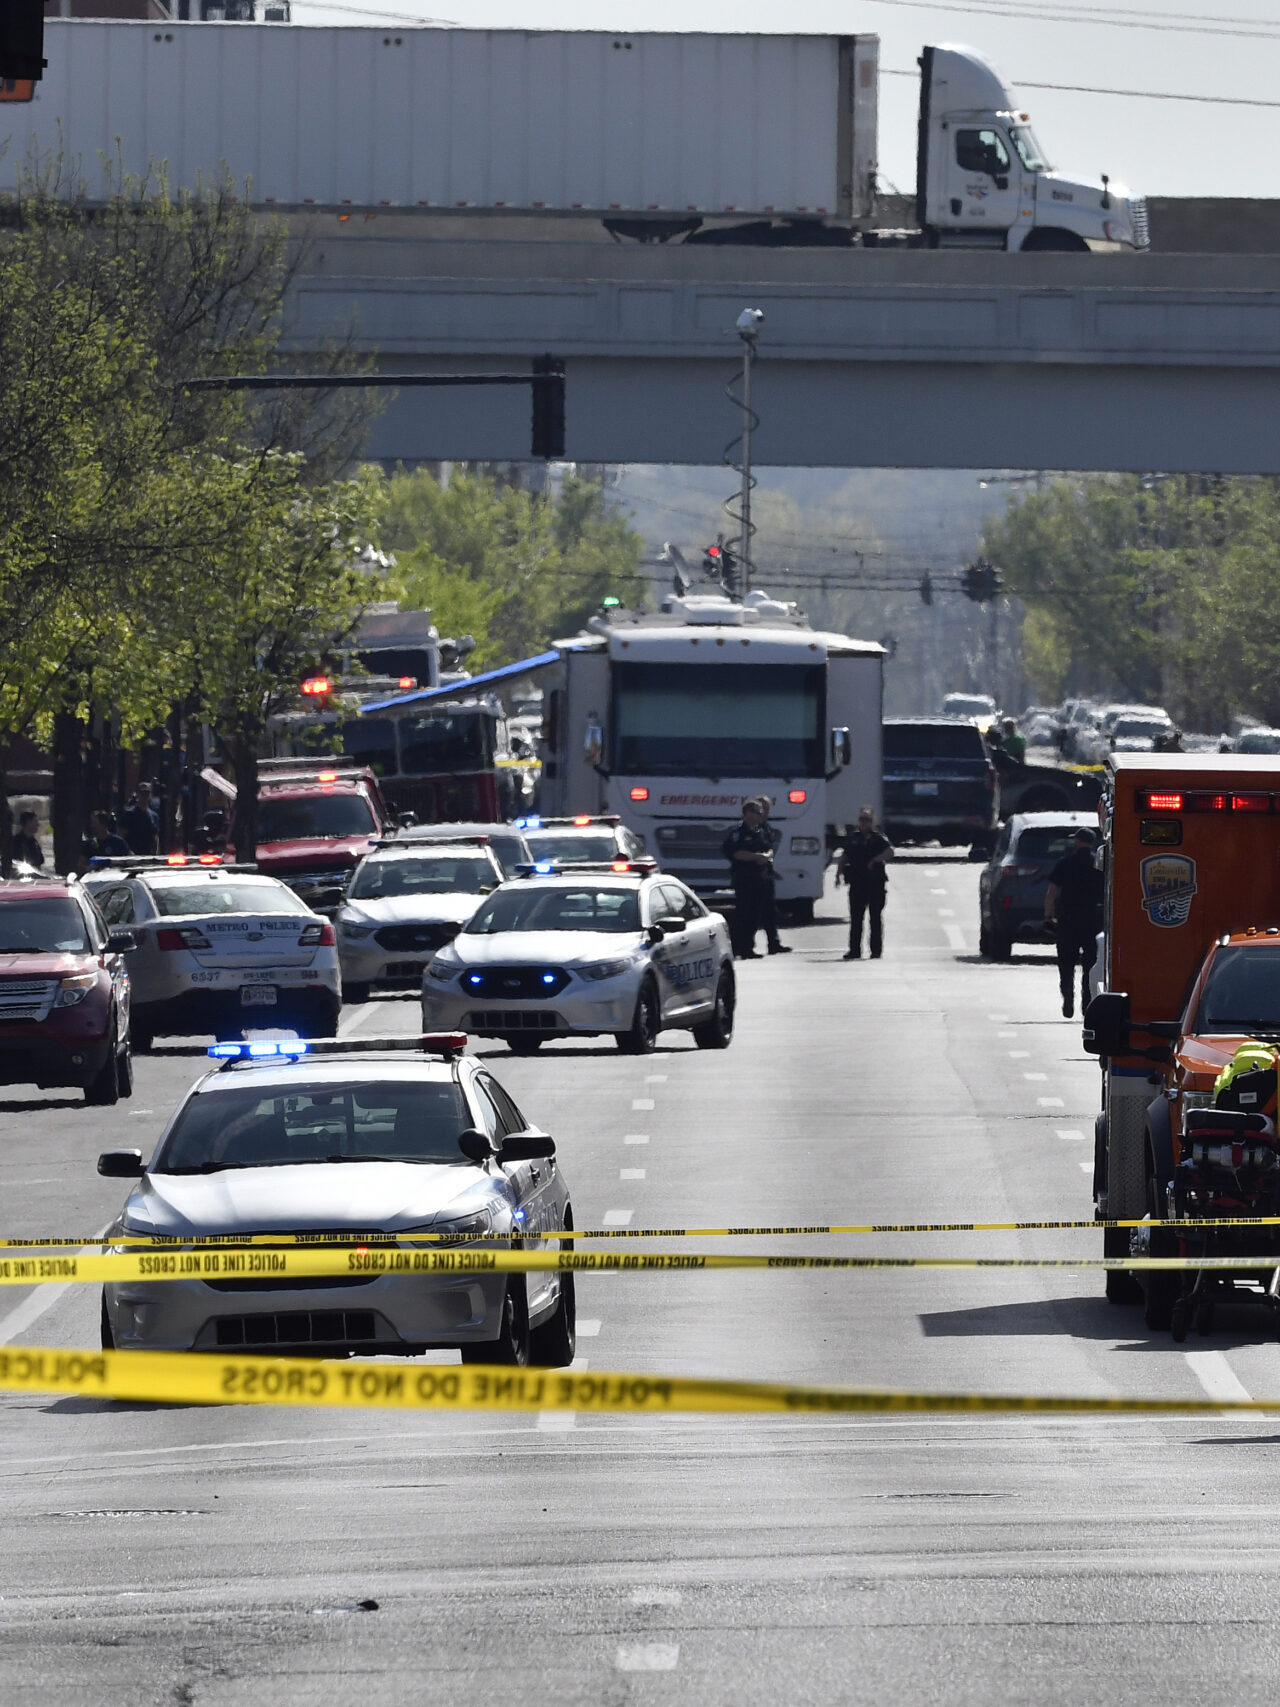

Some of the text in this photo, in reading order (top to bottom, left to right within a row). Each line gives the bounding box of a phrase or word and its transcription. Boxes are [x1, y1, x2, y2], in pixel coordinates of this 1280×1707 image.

[660, 794, 748, 806] EMERGENCY
[206, 921, 301, 932] METRO POLICE
[669, 957, 714, 984] POLICE
[14, 1261, 36, 1277] LINE
[40, 1260, 77, 1277] POLICE
[139, 1254, 286, 1274] POLICE LINE DO NOT CROSS
[348, 1253, 496, 1270] POLICE LINE DO NOT CROSS
[558, 1254, 706, 1269] POLICE LINE DO NOT CROSS
